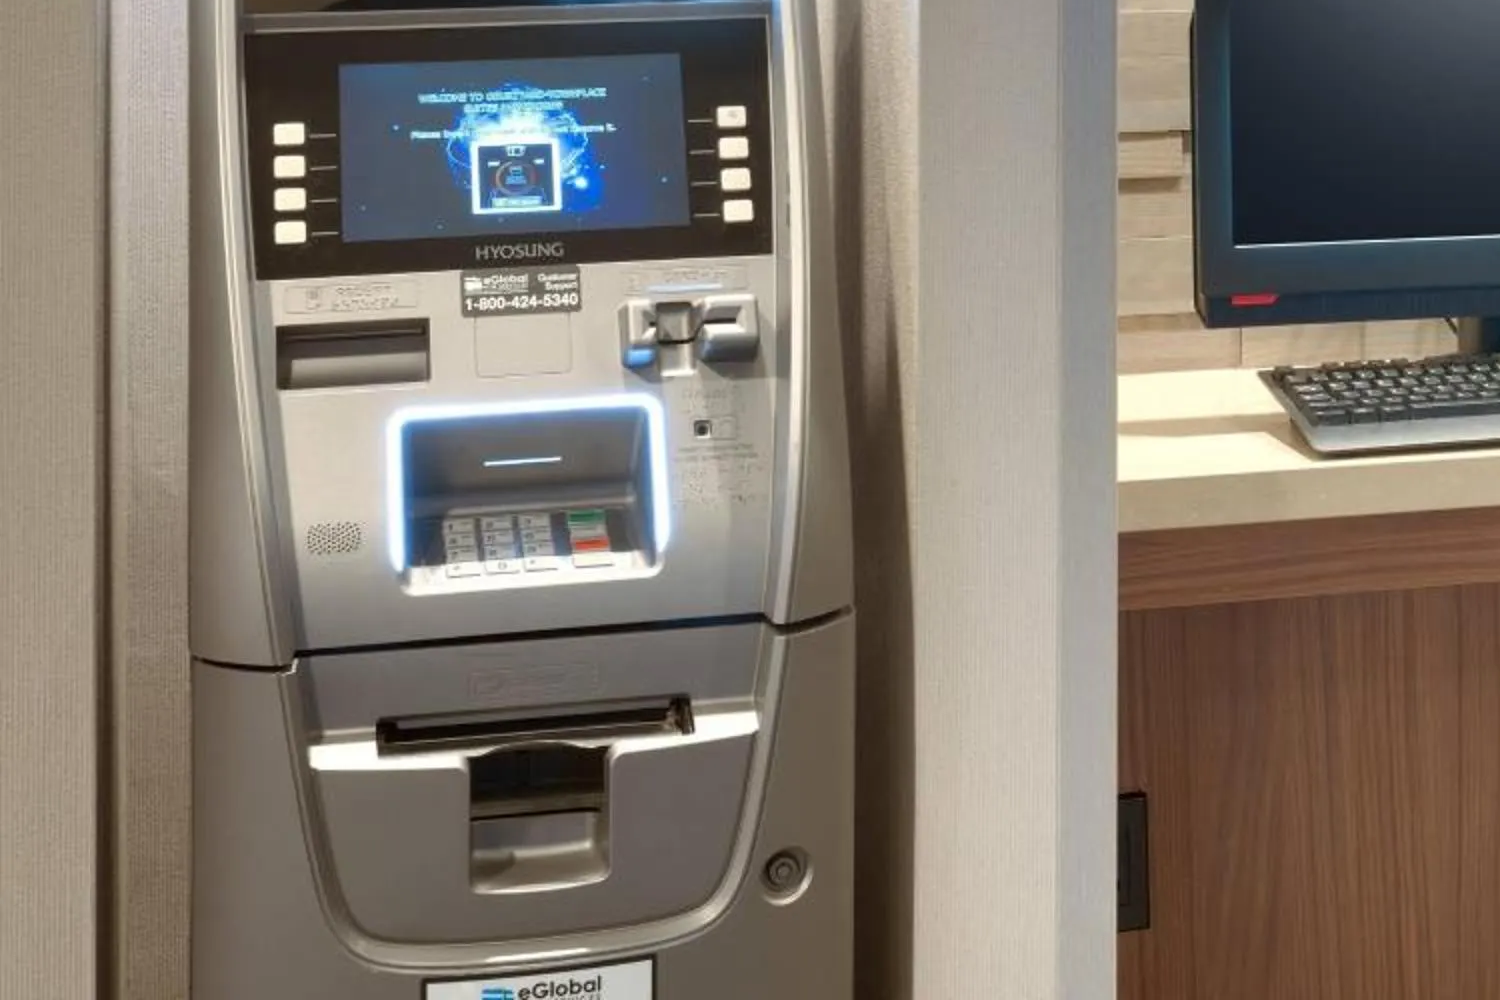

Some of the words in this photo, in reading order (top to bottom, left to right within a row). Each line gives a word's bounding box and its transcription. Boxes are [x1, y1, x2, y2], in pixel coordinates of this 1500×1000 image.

[475, 242, 565, 259] HYOSUNG
[465, 292, 579, 311] 1-800-424-5340
[517, 975, 602, 1000] eGlobal
